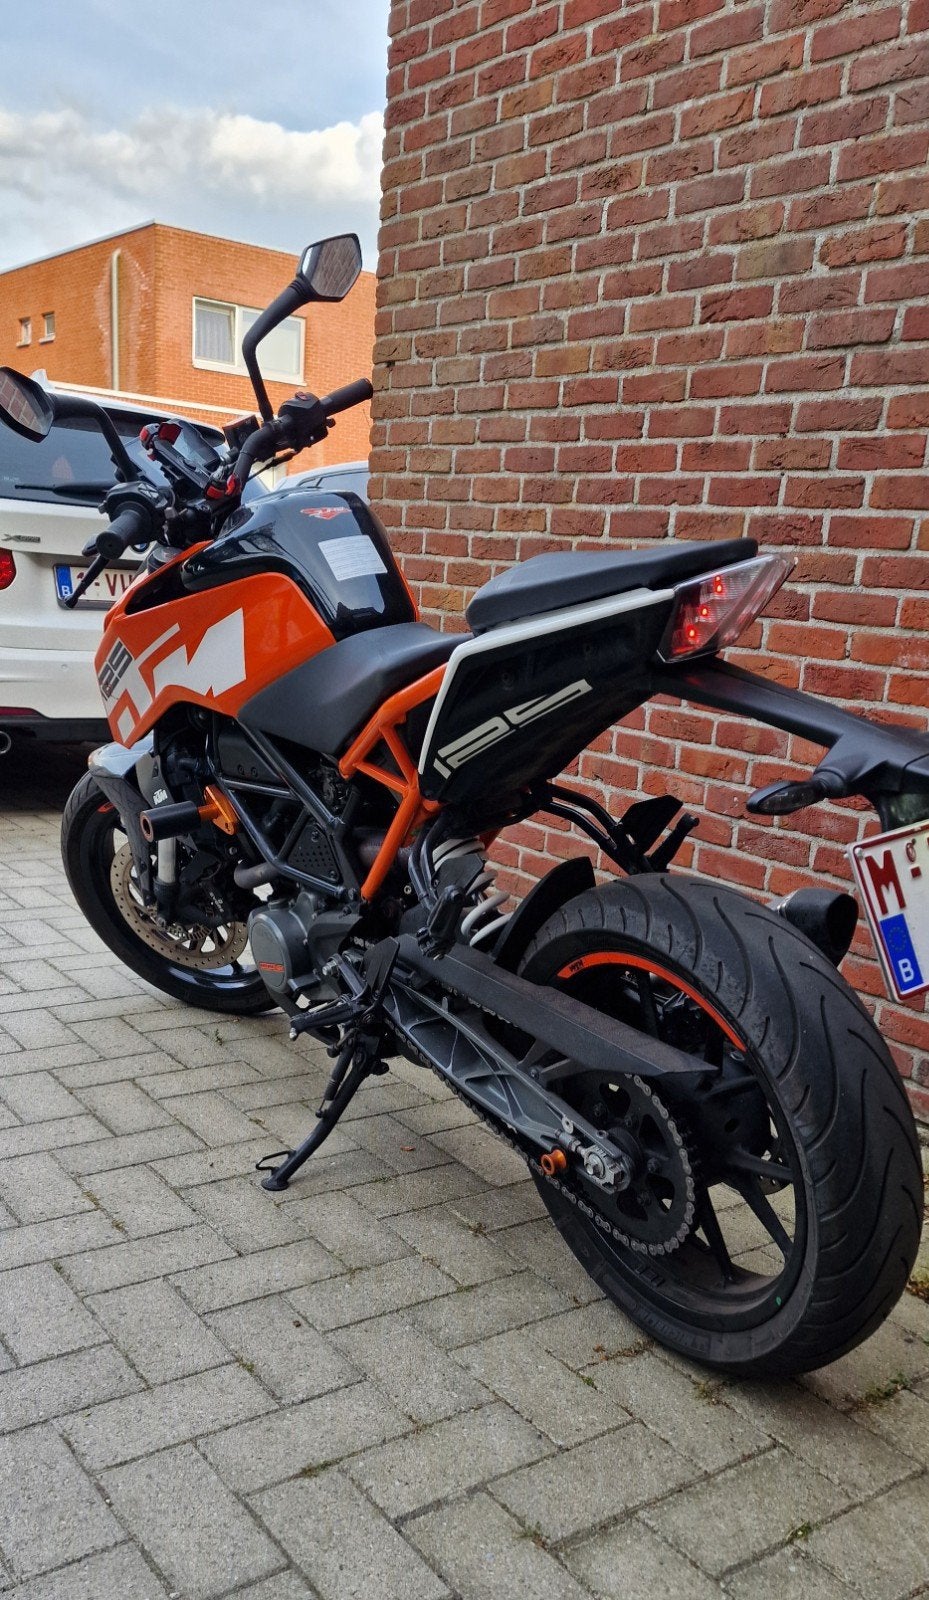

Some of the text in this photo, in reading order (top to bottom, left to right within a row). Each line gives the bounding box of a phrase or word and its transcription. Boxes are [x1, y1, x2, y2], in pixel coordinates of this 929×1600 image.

[61, 585, 71, 597] B
[433, 679, 593, 780] 125
[153, 788, 168, 805] KTM
[898, 958, 915, 983] B
